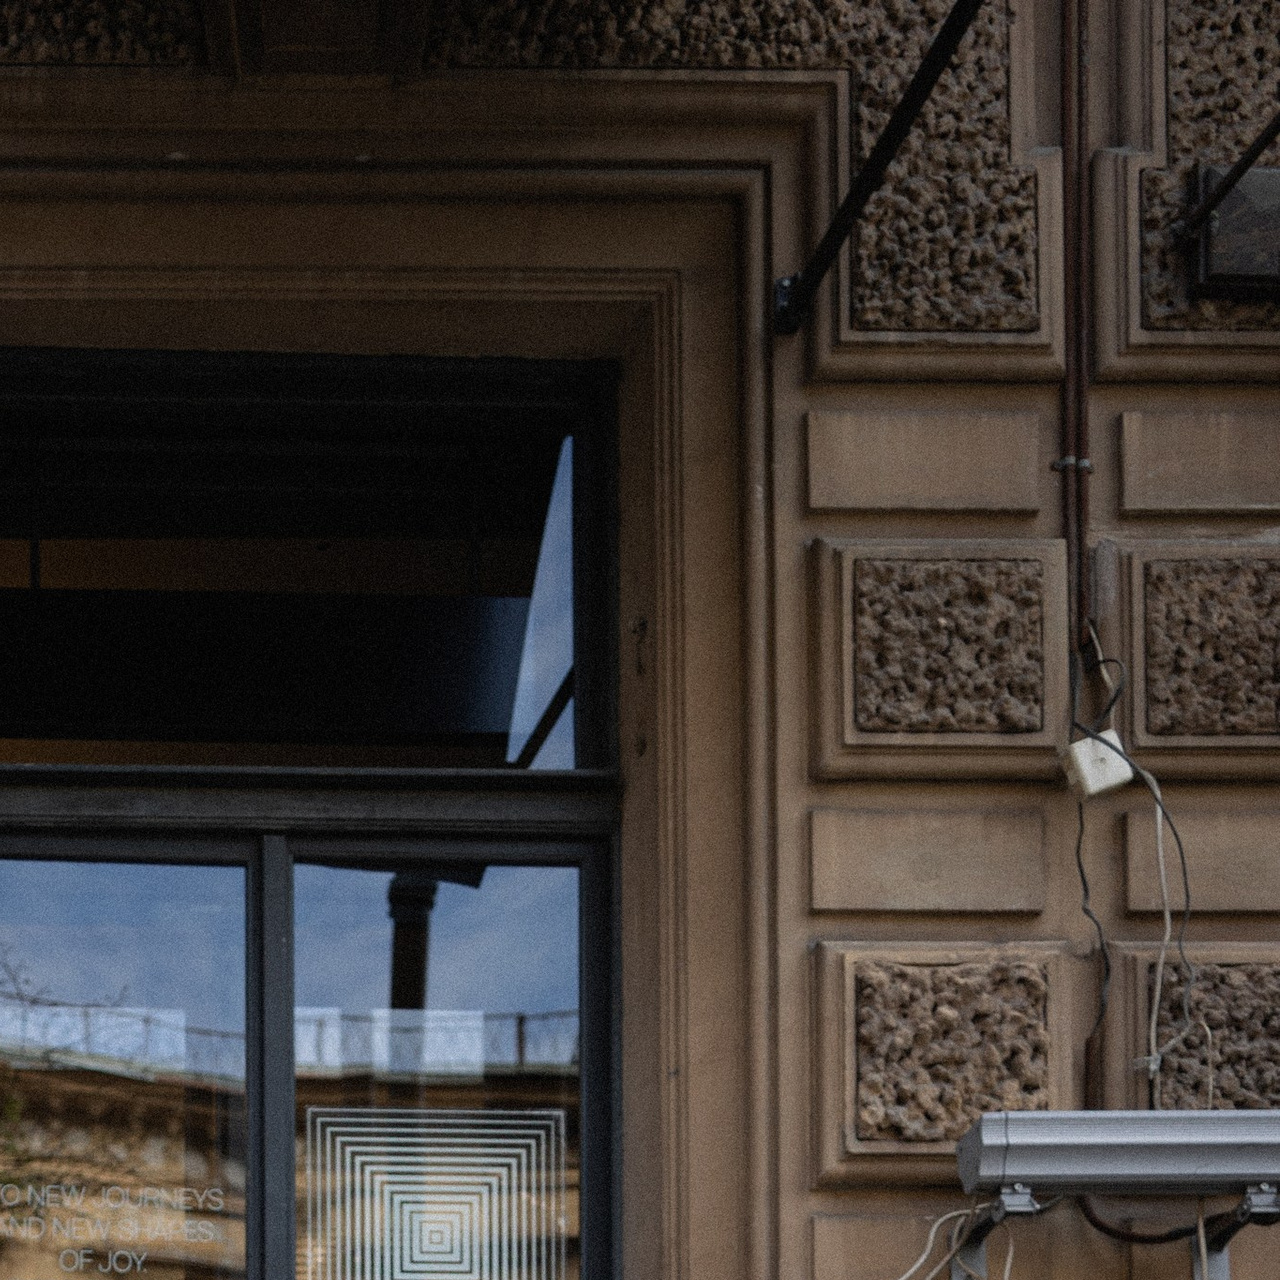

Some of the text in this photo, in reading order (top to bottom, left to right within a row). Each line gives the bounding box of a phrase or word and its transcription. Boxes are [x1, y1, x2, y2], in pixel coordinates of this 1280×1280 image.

[27, 1184, 86, 1208] NEW
[97, 1185, 225, 1212] JOURNEYS
[52, 1216, 111, 1241] NEW
[120, 1218, 215, 1243] SHAPES
[59, 1249, 147, 1274] OF JOY.
